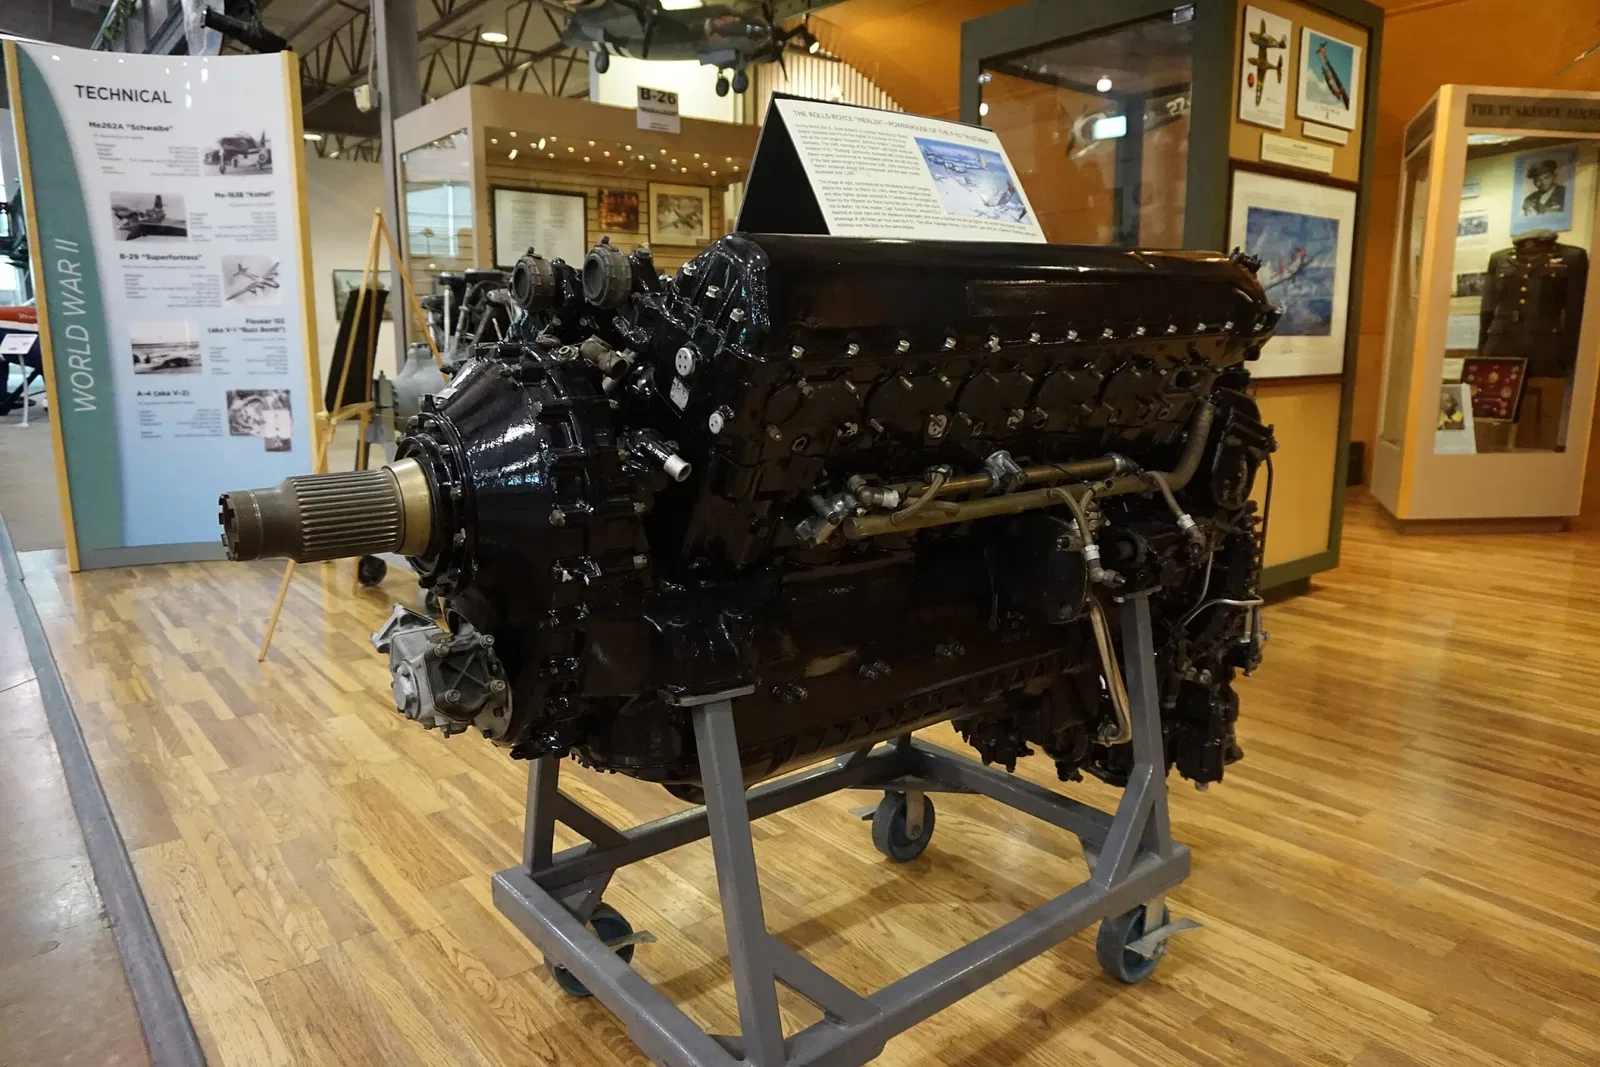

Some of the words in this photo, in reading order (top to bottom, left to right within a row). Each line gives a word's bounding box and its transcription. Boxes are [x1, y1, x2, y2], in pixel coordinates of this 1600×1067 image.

[74, 84, 172, 104] TECHNICAL
[640, 87, 677, 105] B-26
[793, 110, 807, 118] THE
[89, 121, 124, 130] Me262A
[54, 238, 80, 253] II
[119, 253, 139, 261] B-29
[57, 259, 88, 316] WAR
[65, 324, 97, 412] WORLD
